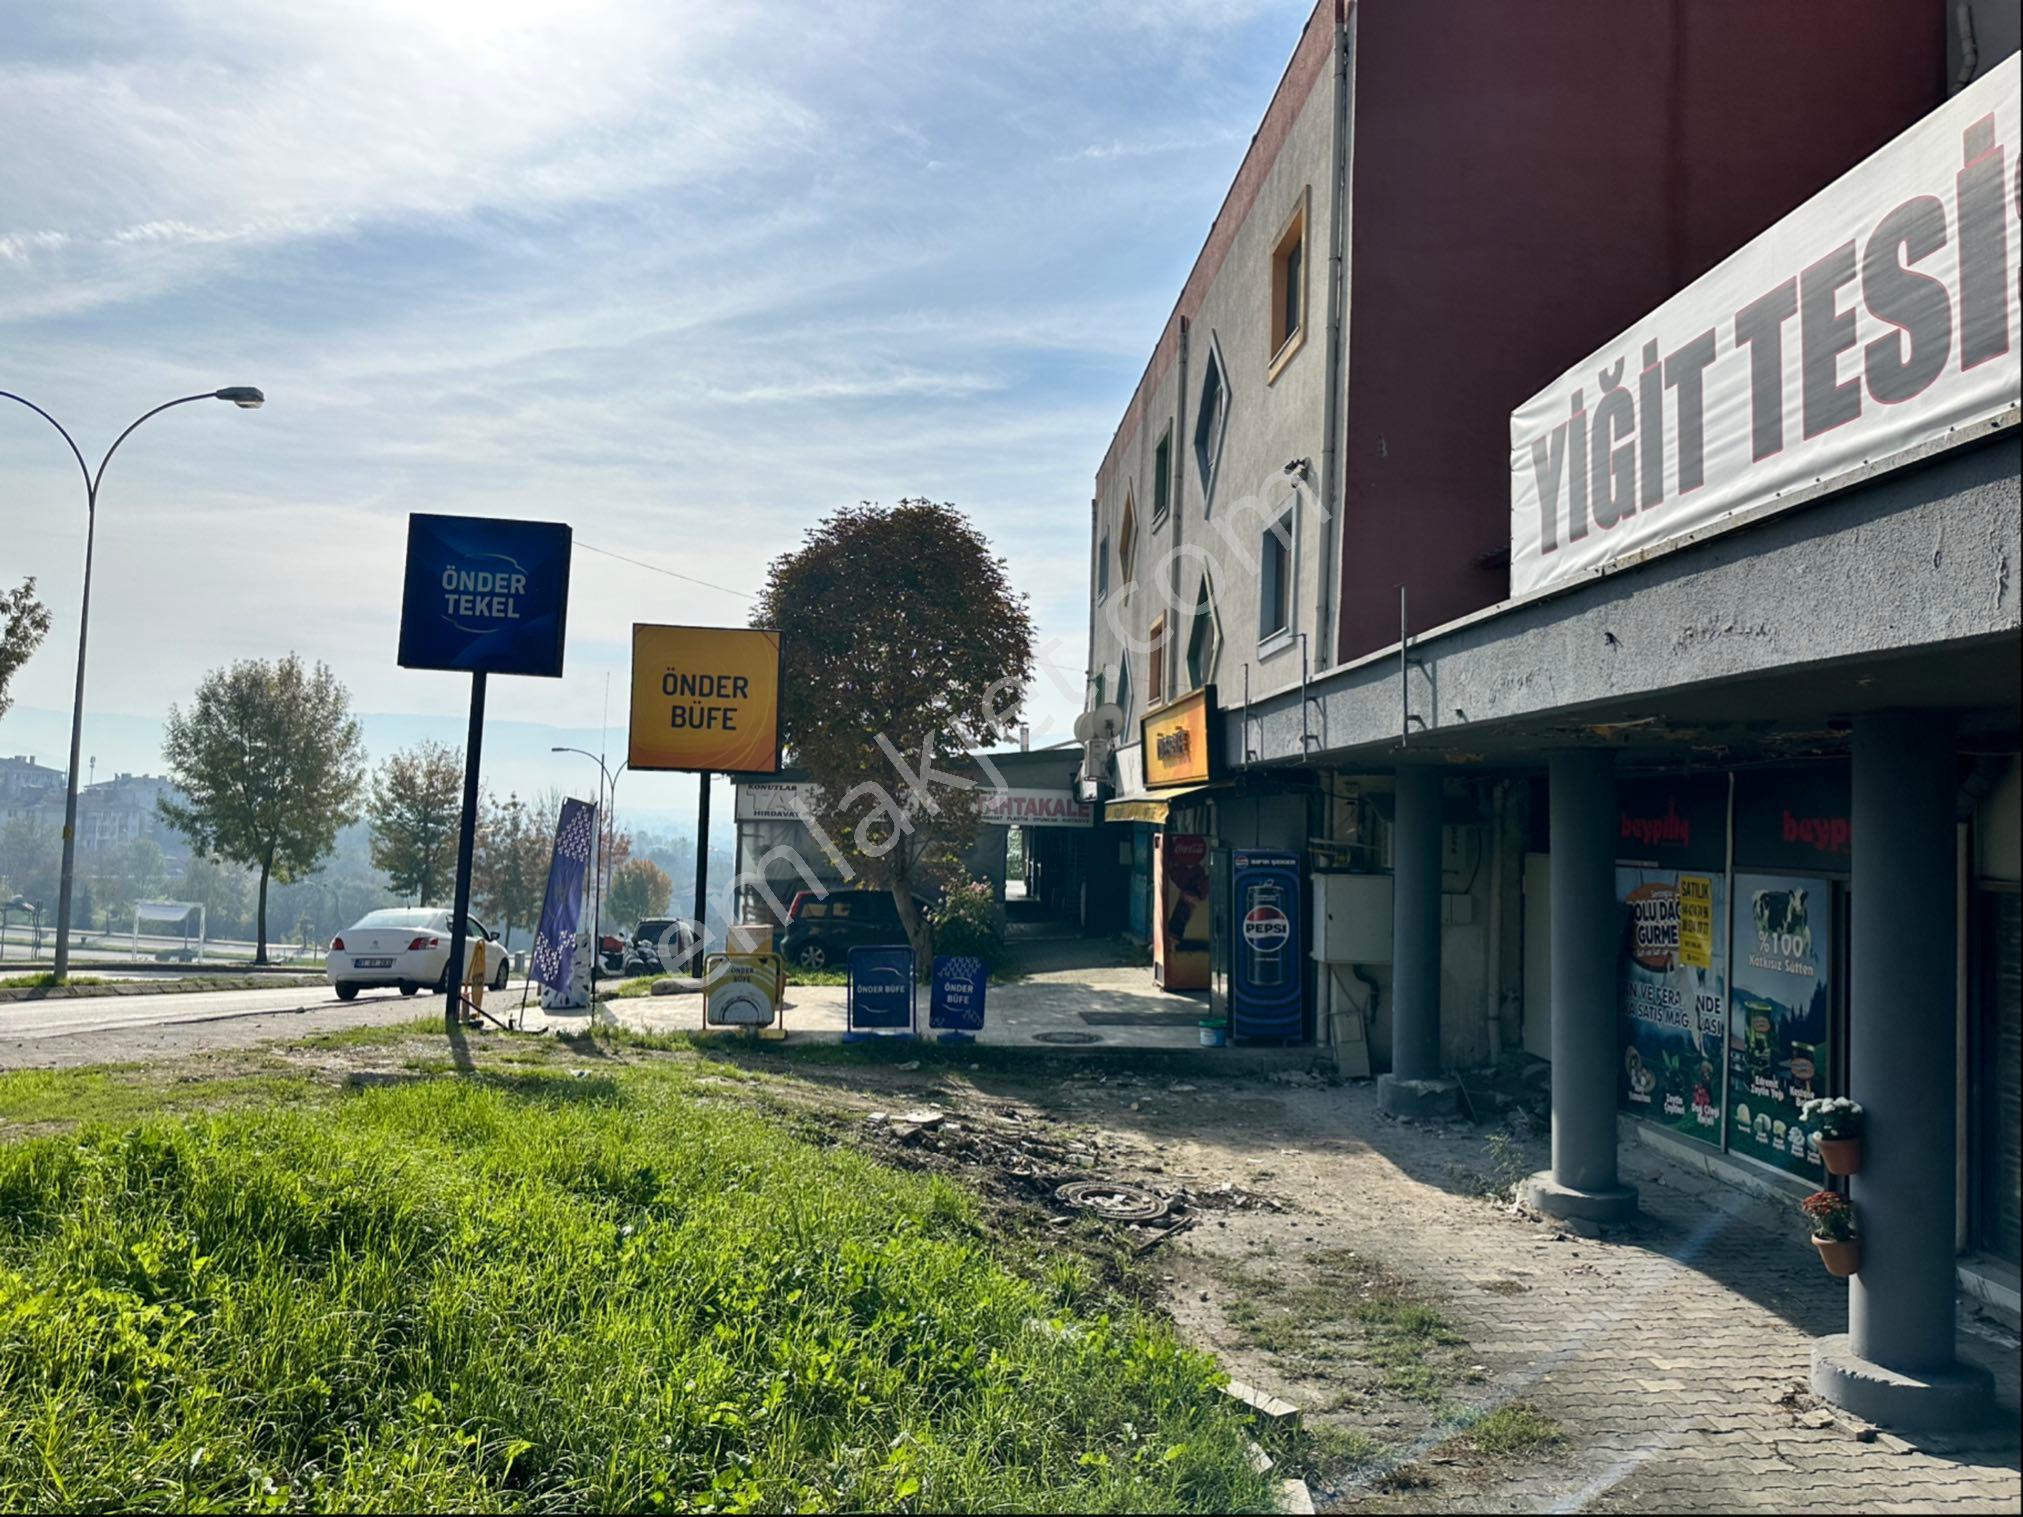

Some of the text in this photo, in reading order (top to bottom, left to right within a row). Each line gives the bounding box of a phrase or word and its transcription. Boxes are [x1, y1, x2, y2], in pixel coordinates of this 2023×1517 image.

[1531, 111, 2022, 555] YİĞİT TESİ
[441, 564, 527, 595] ÖNDER
[444, 594, 521, 618] TEKEL
[661, 667, 749, 699] ÖNDER
[670, 700, 738, 730] BÜFE
[1245, 923, 1287, 934] PEPSI
[1637, 924, 1678, 945] GURME
[856, 983, 906, 994] ÖNDER BÜFE
[943, 981, 974, 993] ÖNDER
[946, 993, 970, 1005] BÜFE
